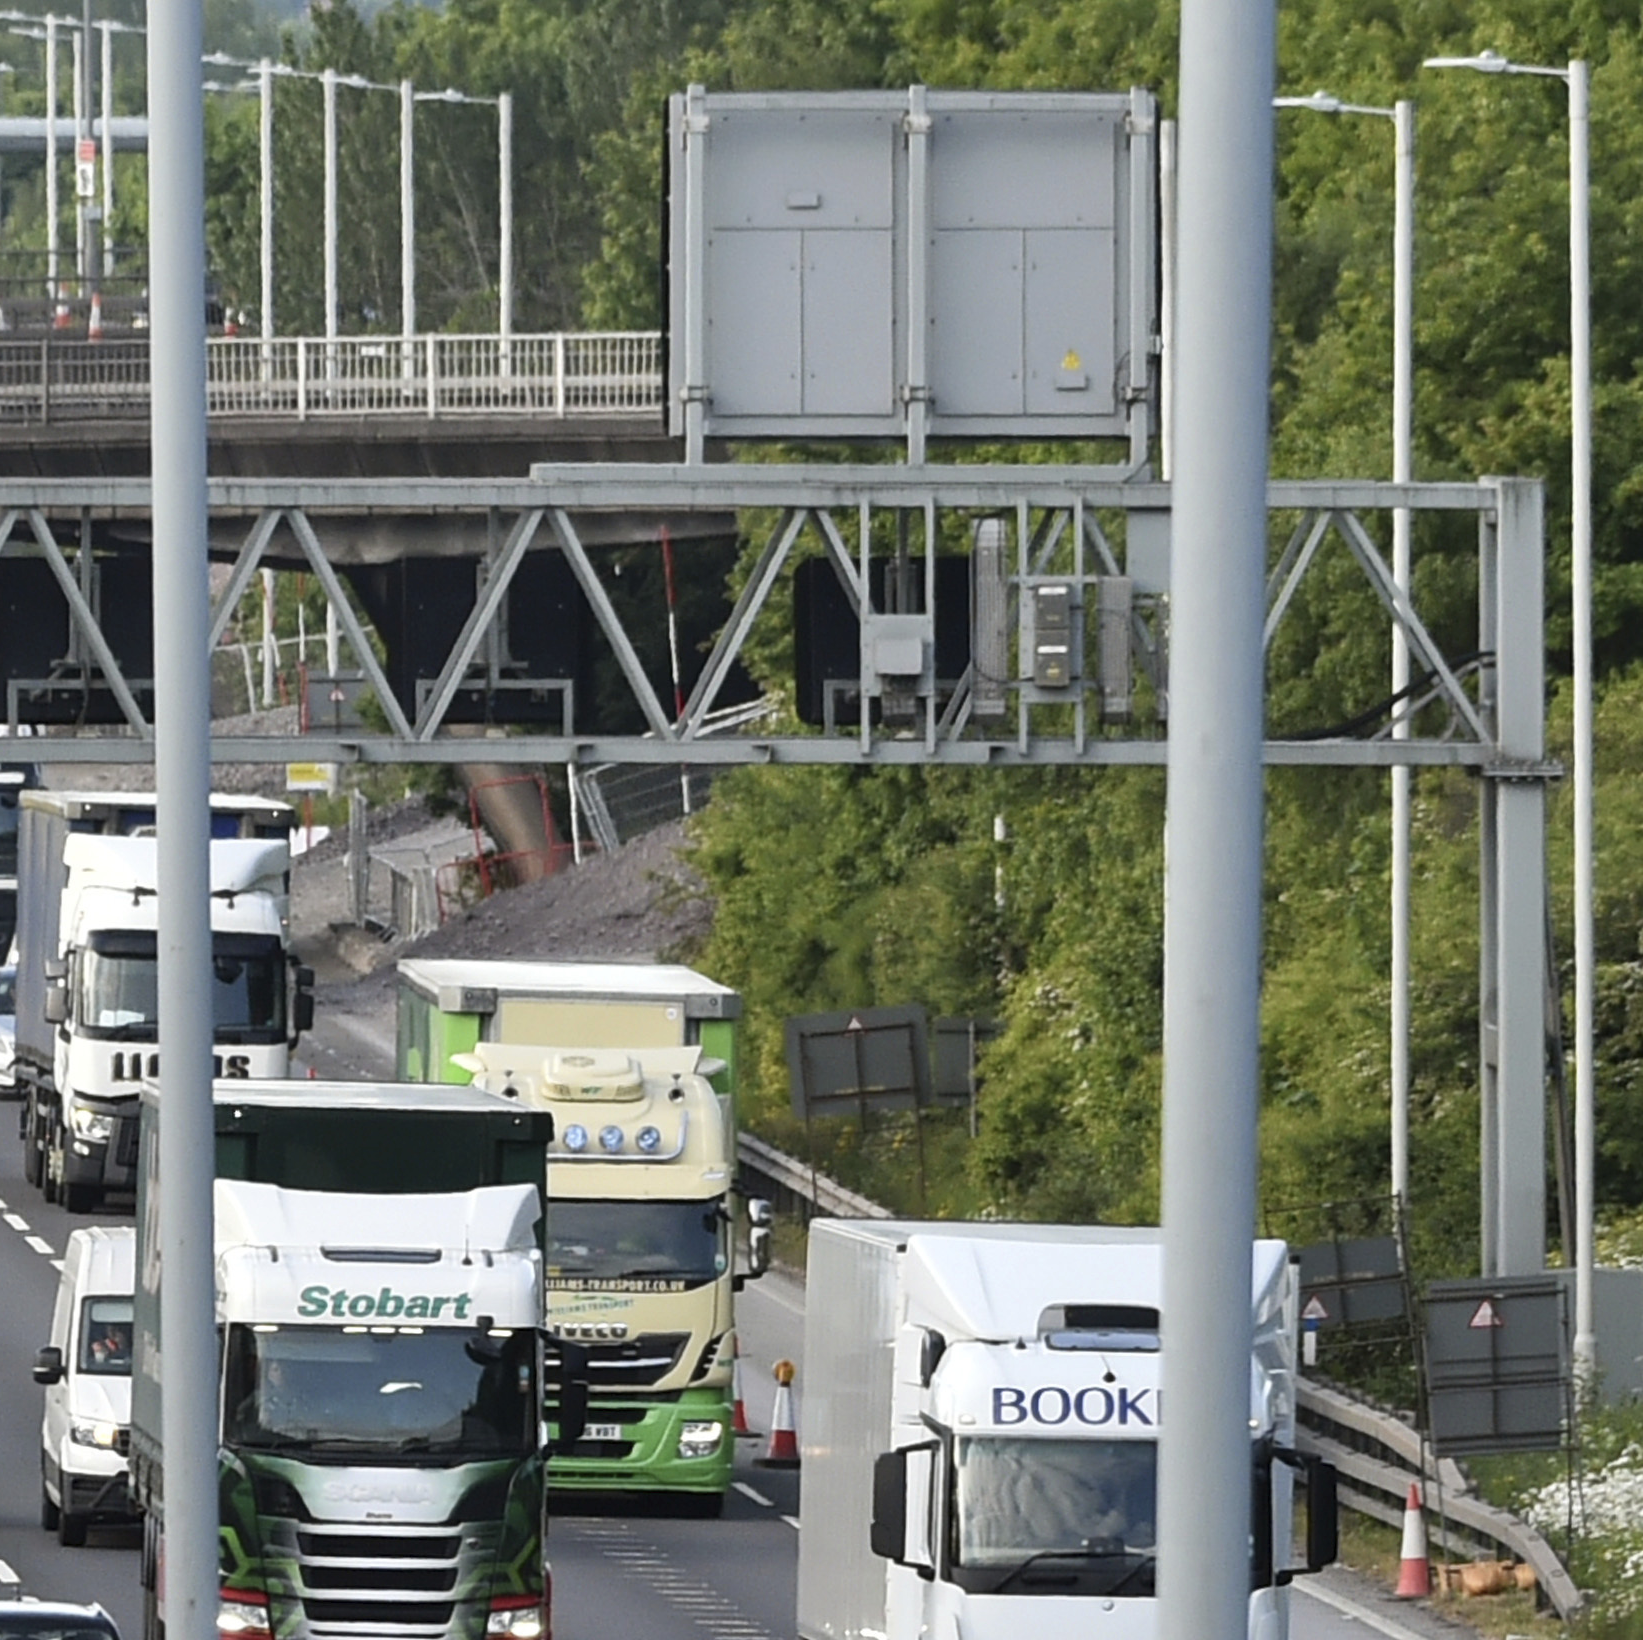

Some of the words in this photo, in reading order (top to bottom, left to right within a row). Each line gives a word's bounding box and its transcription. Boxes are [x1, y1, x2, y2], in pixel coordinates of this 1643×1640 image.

[297, 1285, 472, 1319] Stobart
[553, 1322, 628, 1339] IVECO
[991, 1383, 1161, 1427] BOOK
